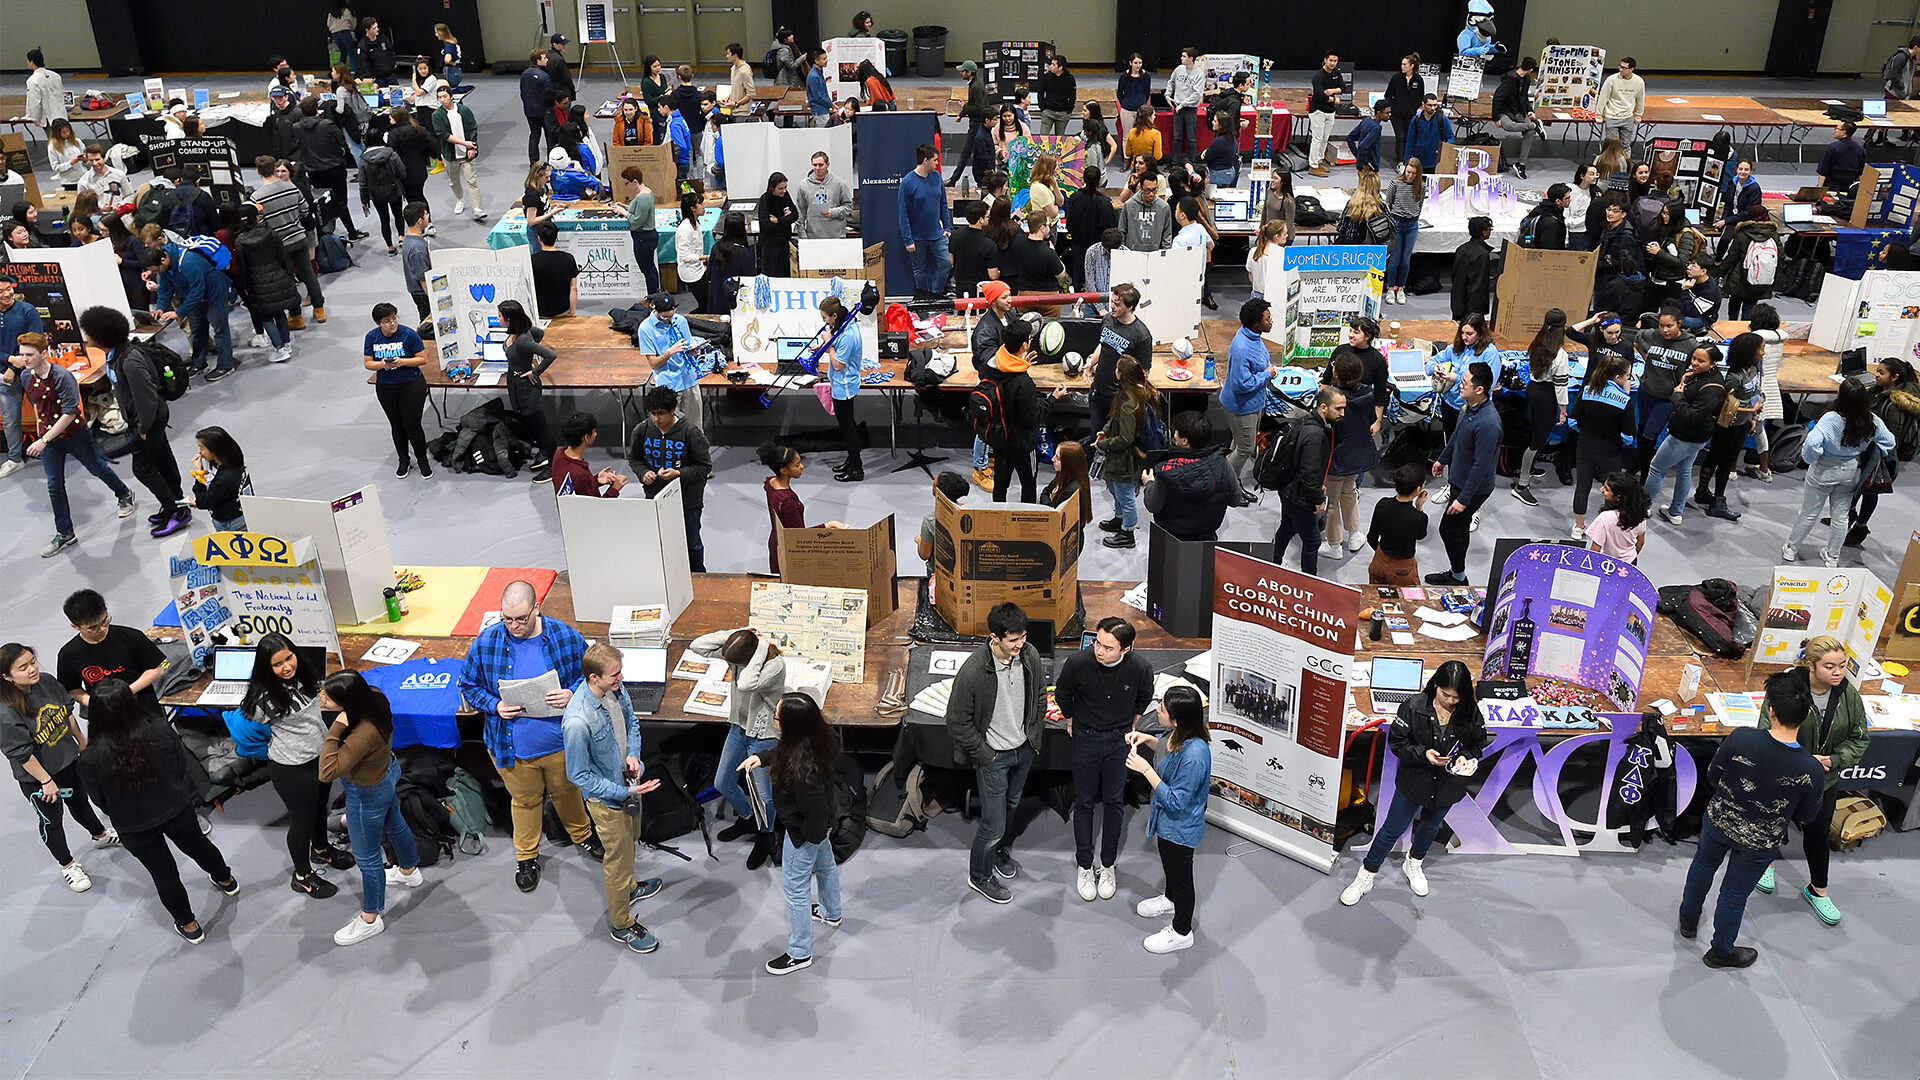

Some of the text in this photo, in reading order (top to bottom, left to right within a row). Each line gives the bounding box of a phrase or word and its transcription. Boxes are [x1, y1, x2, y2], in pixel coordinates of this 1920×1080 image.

[1549, 46, 1589, 57] STEPPING
[1547, 57, 1576, 67] STONE
[1547, 66, 1587, 75] MINISTRY
[148, 139, 176, 151] SHOWS
[179, 140, 226, 148] STAND-UP
[588, 247, 616, 263] SARU
[1286, 252, 1384, 267] WOMEN'S RUGBY
[0, 263, 58, 275] WELCOME TO
[1304, 276, 1361, 286] WHAT THE RUCK
[1335, 285, 1352, 293] YOU
[769, 290, 831, 313] JHU
[1303, 295, 1337, 304] WAITING
[373, 341, 403, 352] HOPKINS
[232, 590, 253, 601] The
[255, 589, 292, 601] National
[1256, 577, 1314, 603] ABOUT
[245, 602, 293, 616] Fraternity
[1223, 582, 1347, 629] GLOBAL CHINA
[238, 614, 294, 636] 5000
[1228, 598, 1339, 642] CONNECTION
[829, 641, 853, 650] SPORTS
[371, 645, 409, 659] C12
[1306, 655, 1344, 675] GCC
[1312, 674, 1335, 686] Statistics
[1216, 723, 1256, 741] Past Events
